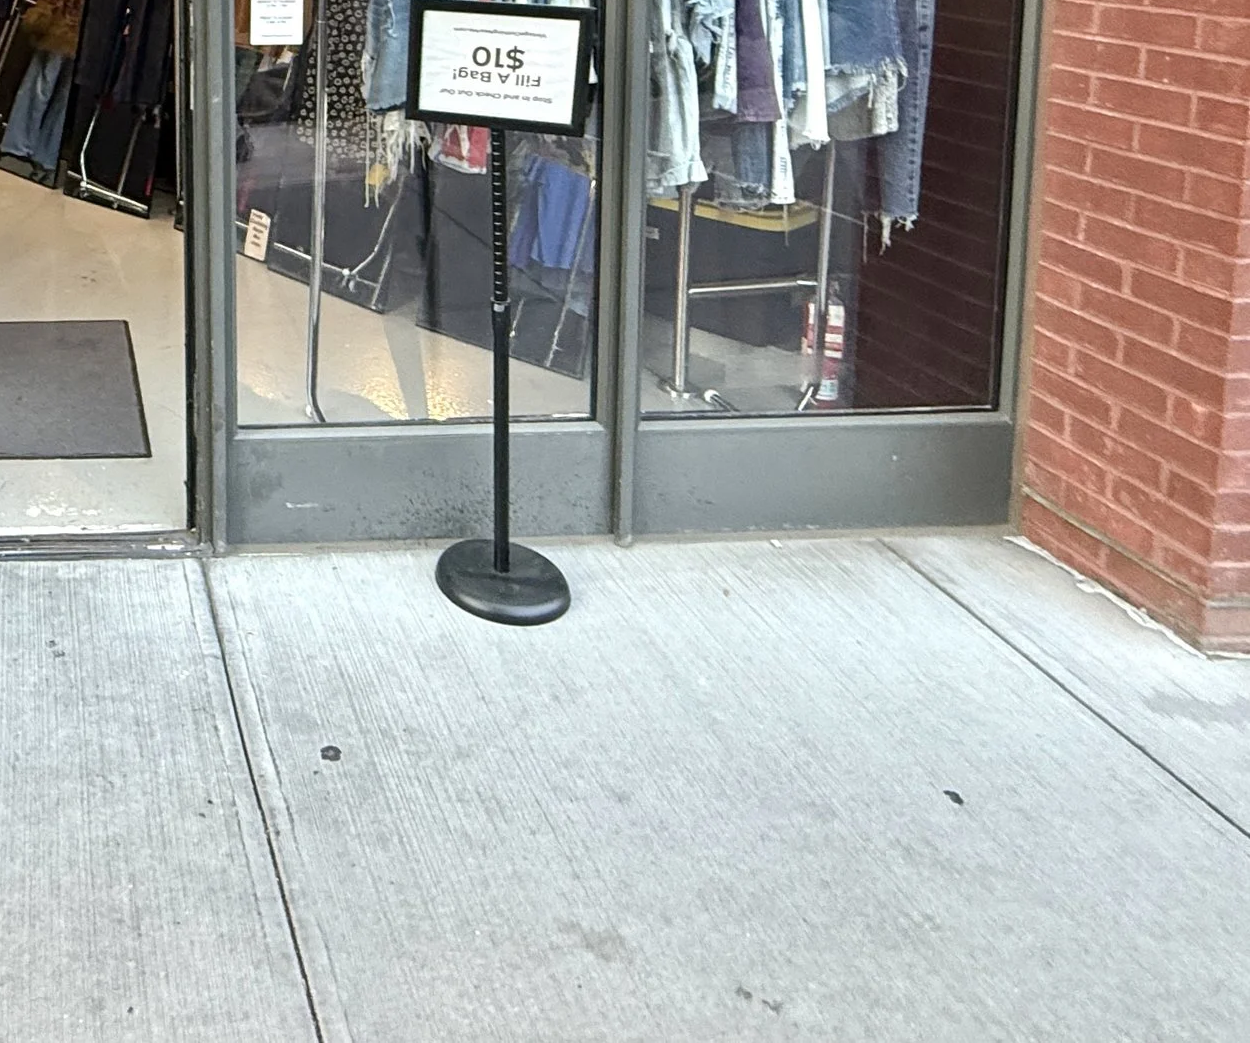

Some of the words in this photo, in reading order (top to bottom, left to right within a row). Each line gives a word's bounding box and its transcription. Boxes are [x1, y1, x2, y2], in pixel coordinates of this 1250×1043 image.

[472, 45, 525, 72] $10
[452, 67, 491, 83] Bag!
[498, 73, 510, 84] A
[516, 74, 541, 87] Fill
